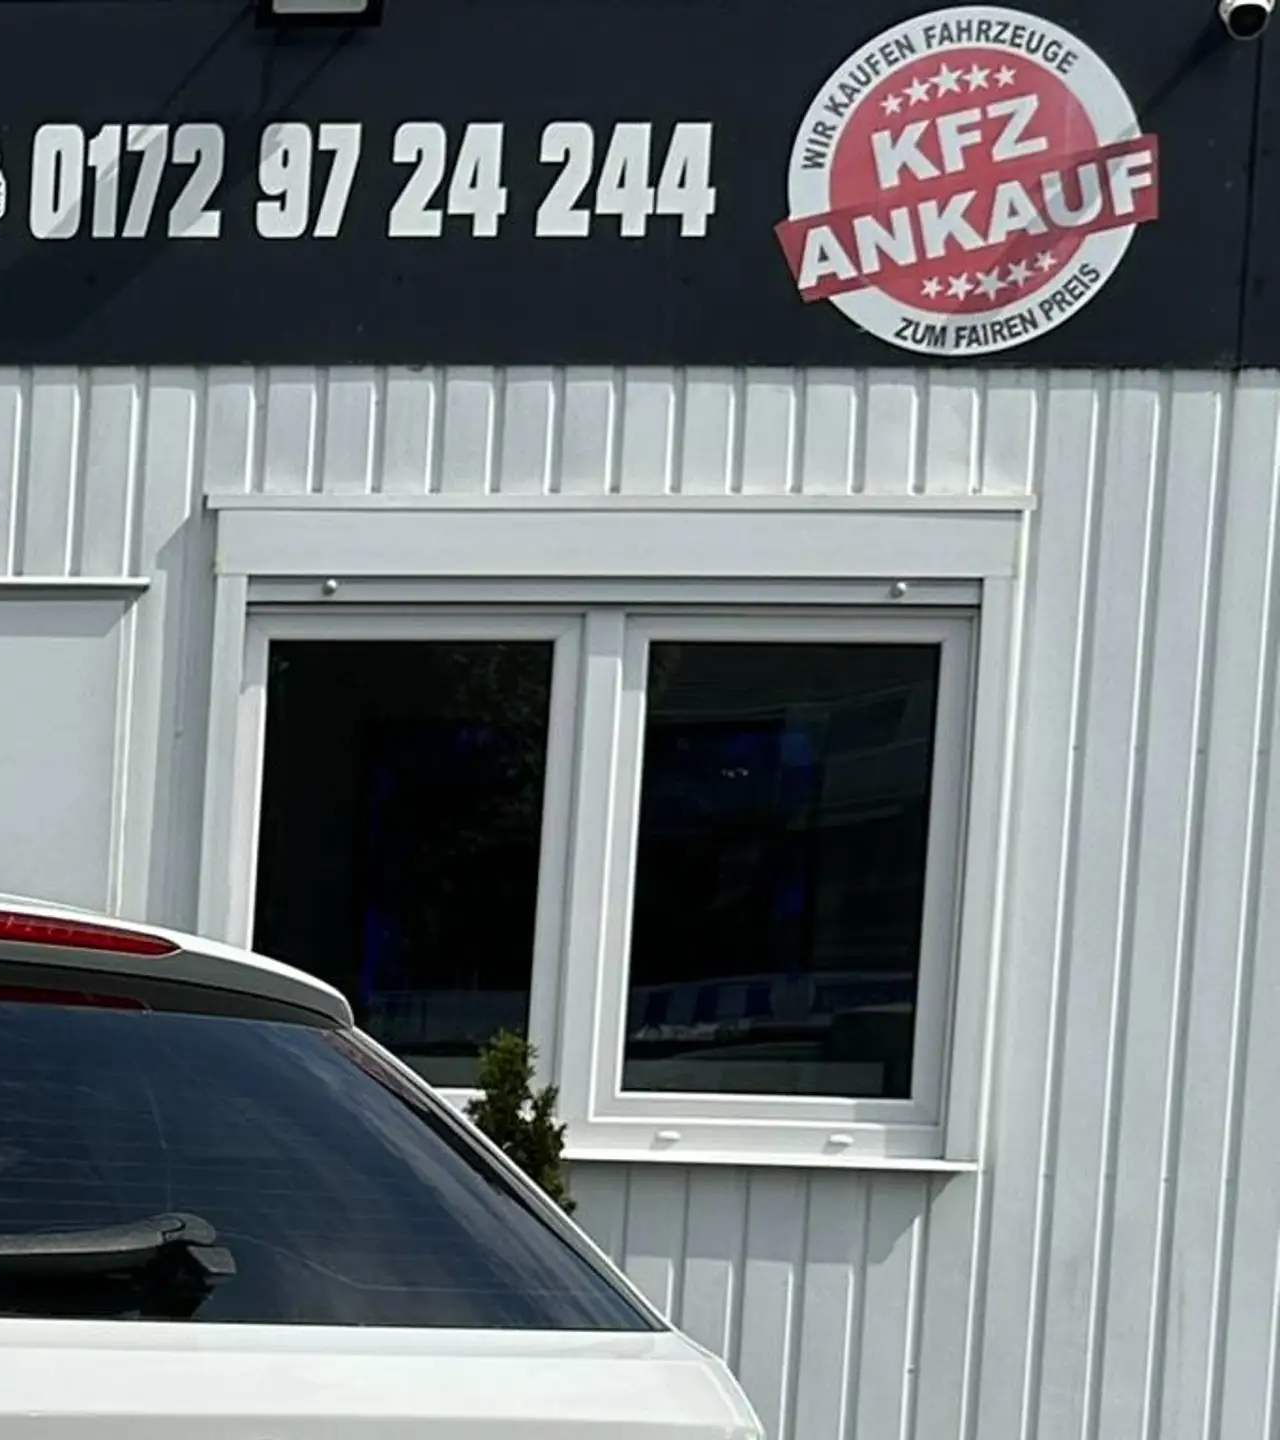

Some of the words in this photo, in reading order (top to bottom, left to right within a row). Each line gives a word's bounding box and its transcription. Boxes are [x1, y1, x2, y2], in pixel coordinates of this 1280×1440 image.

[801, 119, 836, 171] WIR
[824, 33, 916, 118] KAUFEN
[923, 19, 1078, 74] FAHRZEUGE
[871, 93, 1049, 191] KFZ
[29, 121, 226, 239] 0172
[254, 121, 363, 238] 97
[386, 121, 507, 238] 24
[534, 121, 717, 237] 244
[797, 150, 1153, 290] ANKAUF
[894, 316, 948, 348] ZUM
[954, 308, 1039, 349] FAIREN
[1040, 262, 1101, 322] PREIS
